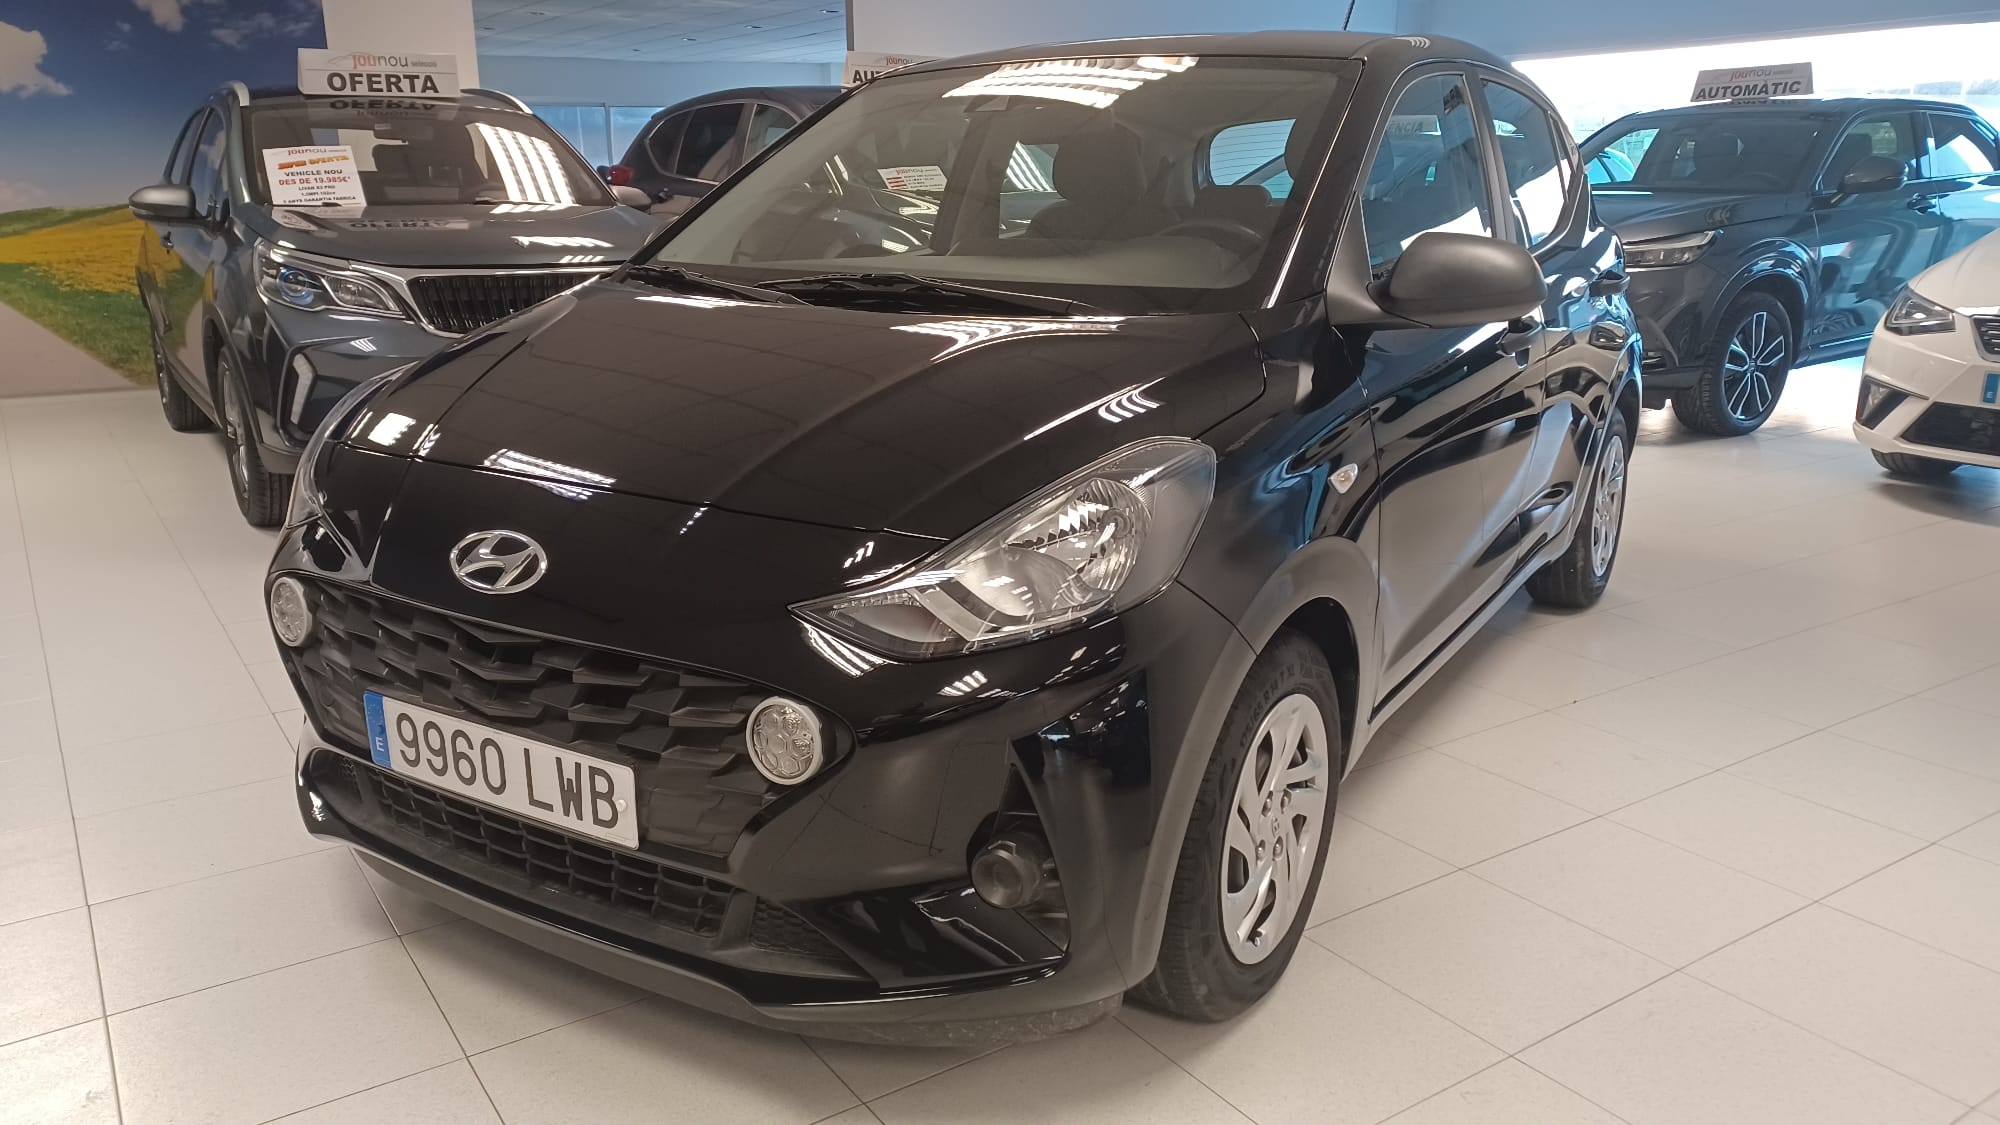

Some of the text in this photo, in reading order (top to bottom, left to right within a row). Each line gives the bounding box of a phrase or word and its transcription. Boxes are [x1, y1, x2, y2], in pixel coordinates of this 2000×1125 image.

[326, 72, 440, 94] OFERTA
[852, 70, 886, 84] AU
[1695, 80, 1803, 100] AUTOMÀTIC
[375, 736, 385, 752] E
[396, 712, 620, 830] 9960 LWB
